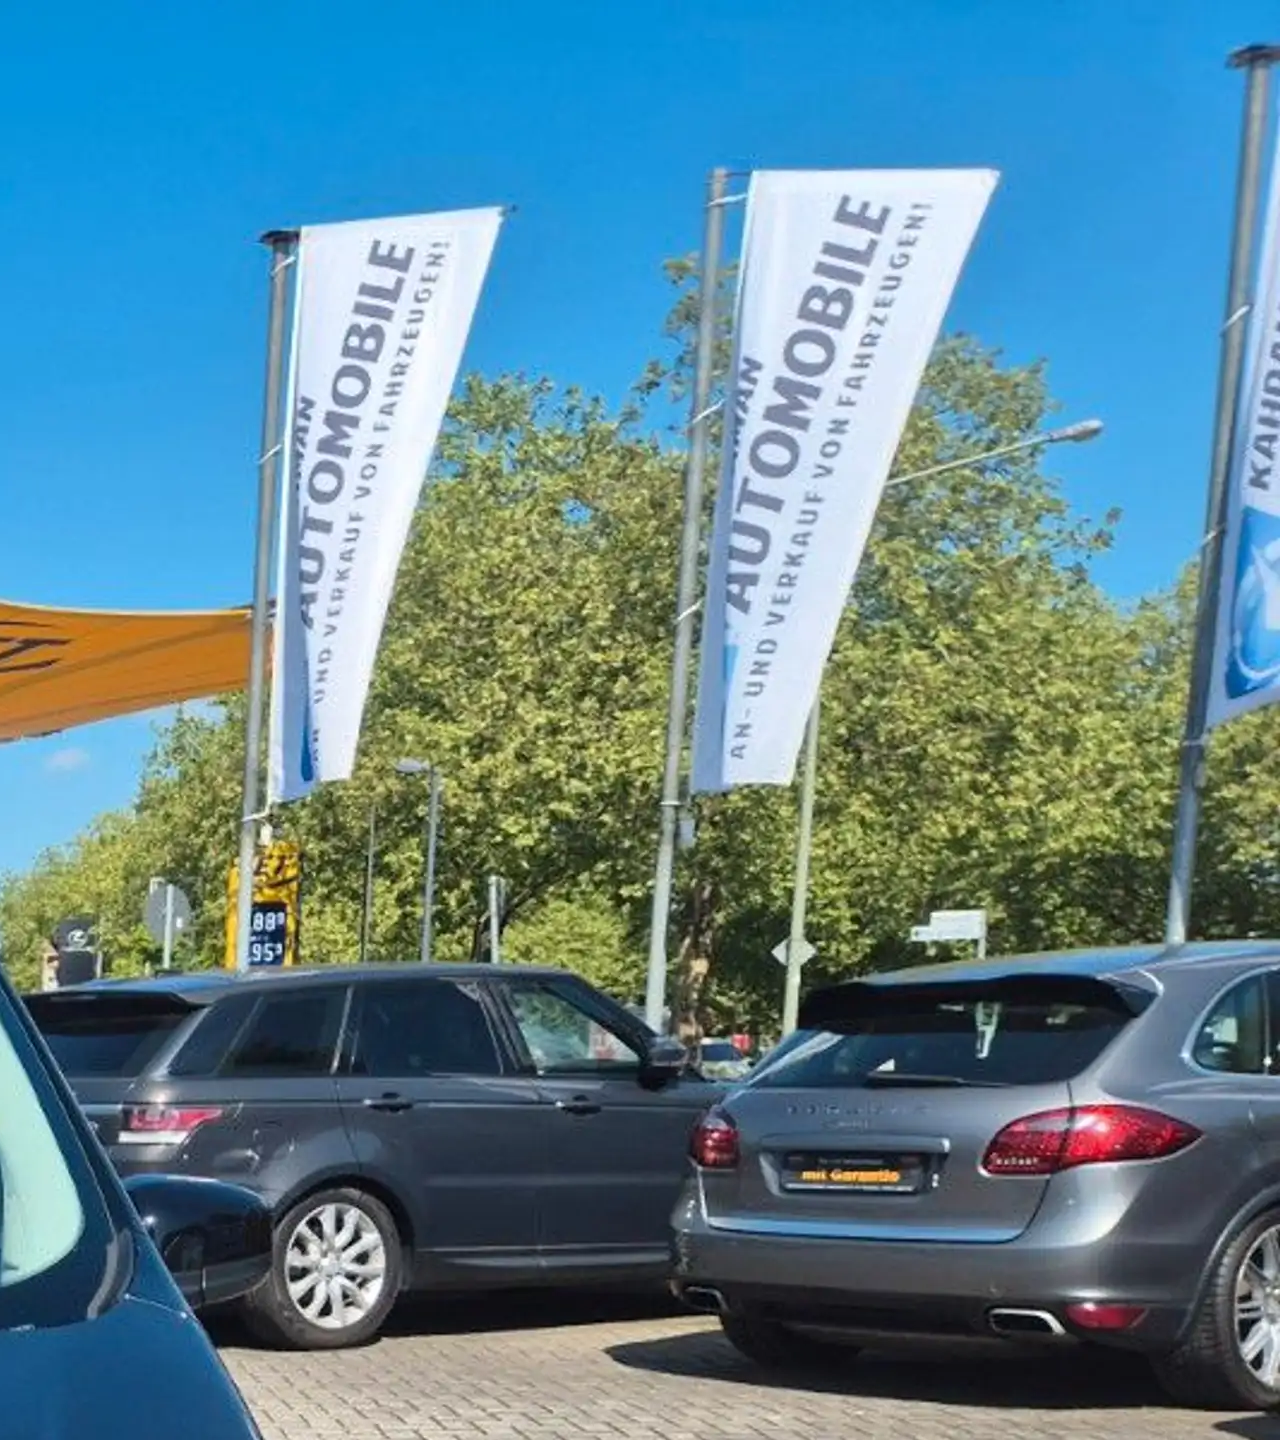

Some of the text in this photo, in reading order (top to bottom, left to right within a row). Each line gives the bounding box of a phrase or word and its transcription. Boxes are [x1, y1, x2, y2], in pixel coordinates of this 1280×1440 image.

[300, 239, 416, 630] AUTOMOBILE
[323, 511, 365, 638] VERKAUF
[353, 443, 384, 500] VON
[372, 240, 451, 432] FAHRZEUGEN!
[726, 194, 892, 616] AUTOMOBILE
[743, 638, 778, 698] UND
[764, 491, 828, 628] VERKAUF
[811, 417, 850, 479] VON
[836, 203, 933, 407] FAHRZEUGEN!
